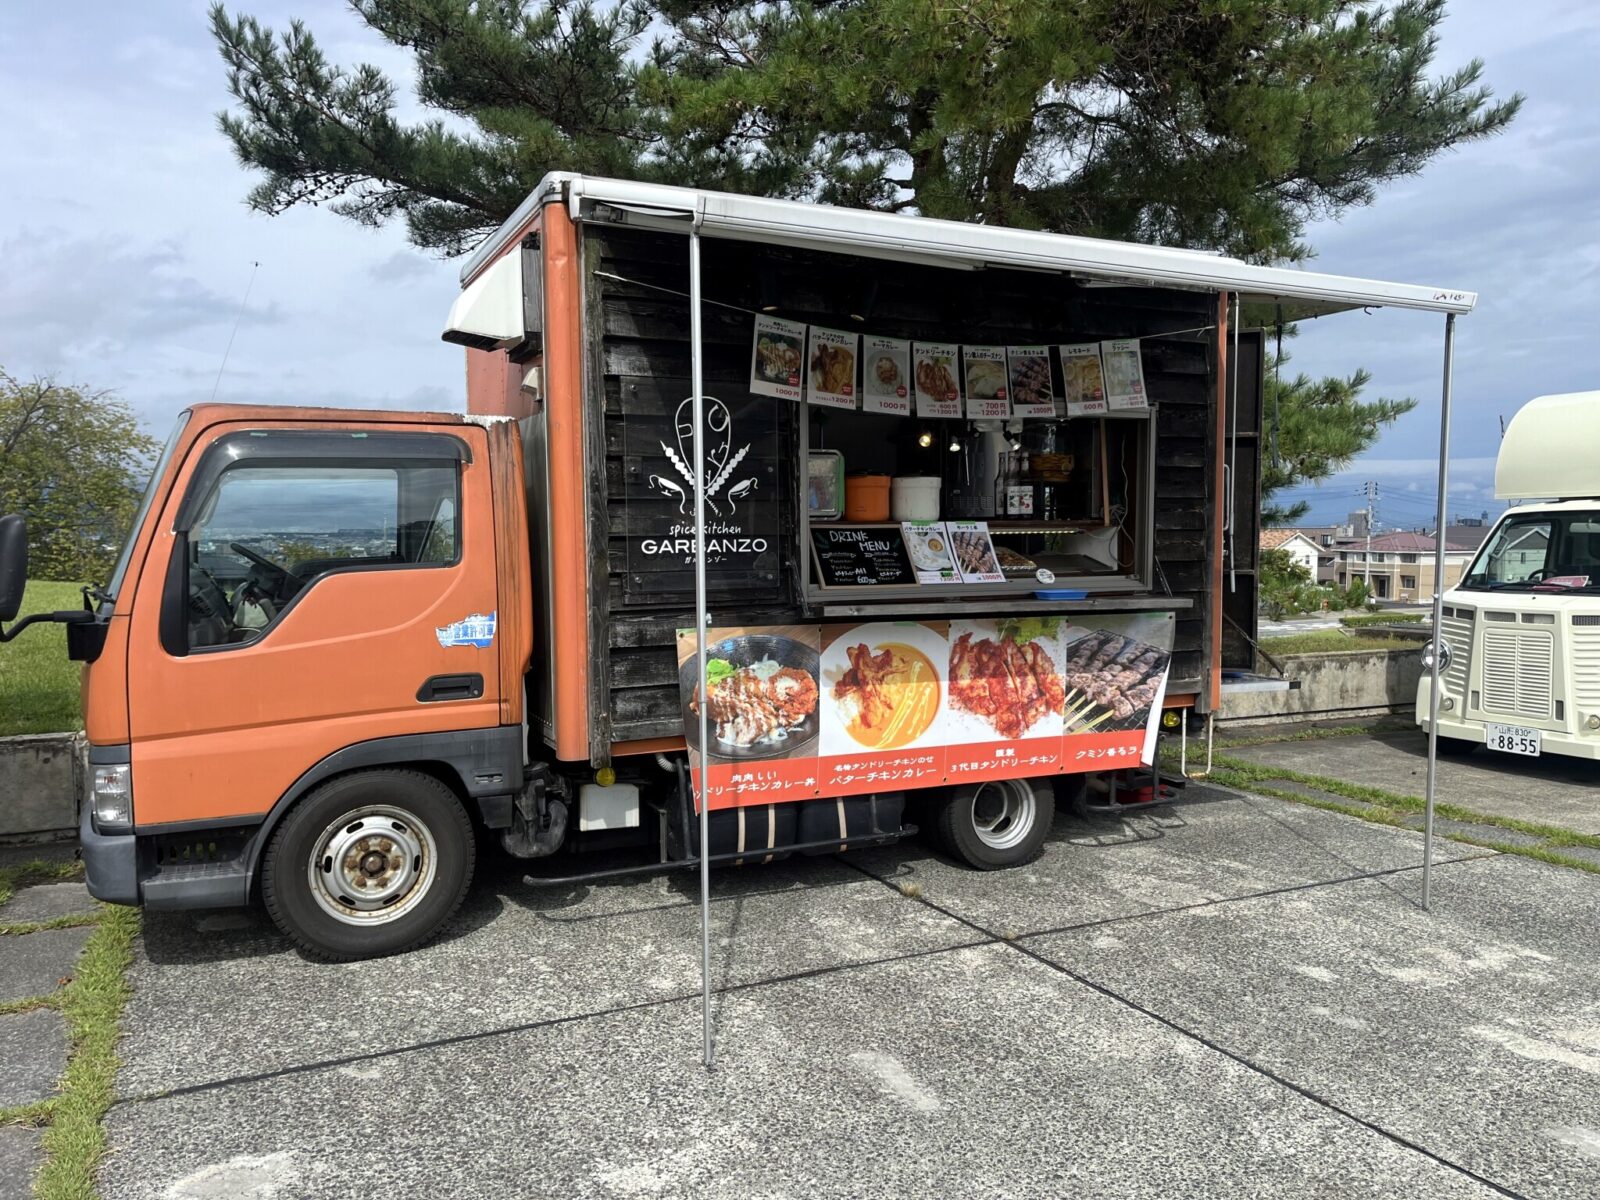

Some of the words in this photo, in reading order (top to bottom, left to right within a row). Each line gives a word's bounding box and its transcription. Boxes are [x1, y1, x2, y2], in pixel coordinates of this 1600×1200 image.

[915, 348, 956, 357] タンドリーチキン
[669, 520, 696, 537] spice
[829, 530, 869, 543] DRINK
[859, 541, 890, 552] MENU
[1514, 728, 1529, 737] 830
[1075, 745, 1142, 760] クミン香るラ
[1498, 735, 1537, 754] 88-55
[833, 755, 935, 772] 名物タンドリーチキンのせ
[950, 755, 1059, 773] 3代目タンドリーチキン
[731, 770, 777, 784] 肉肉しい
[828, 768, 937, 785] バターチキンカレー
[693, 777, 816, 800] ンドリーチキンカレー丼
